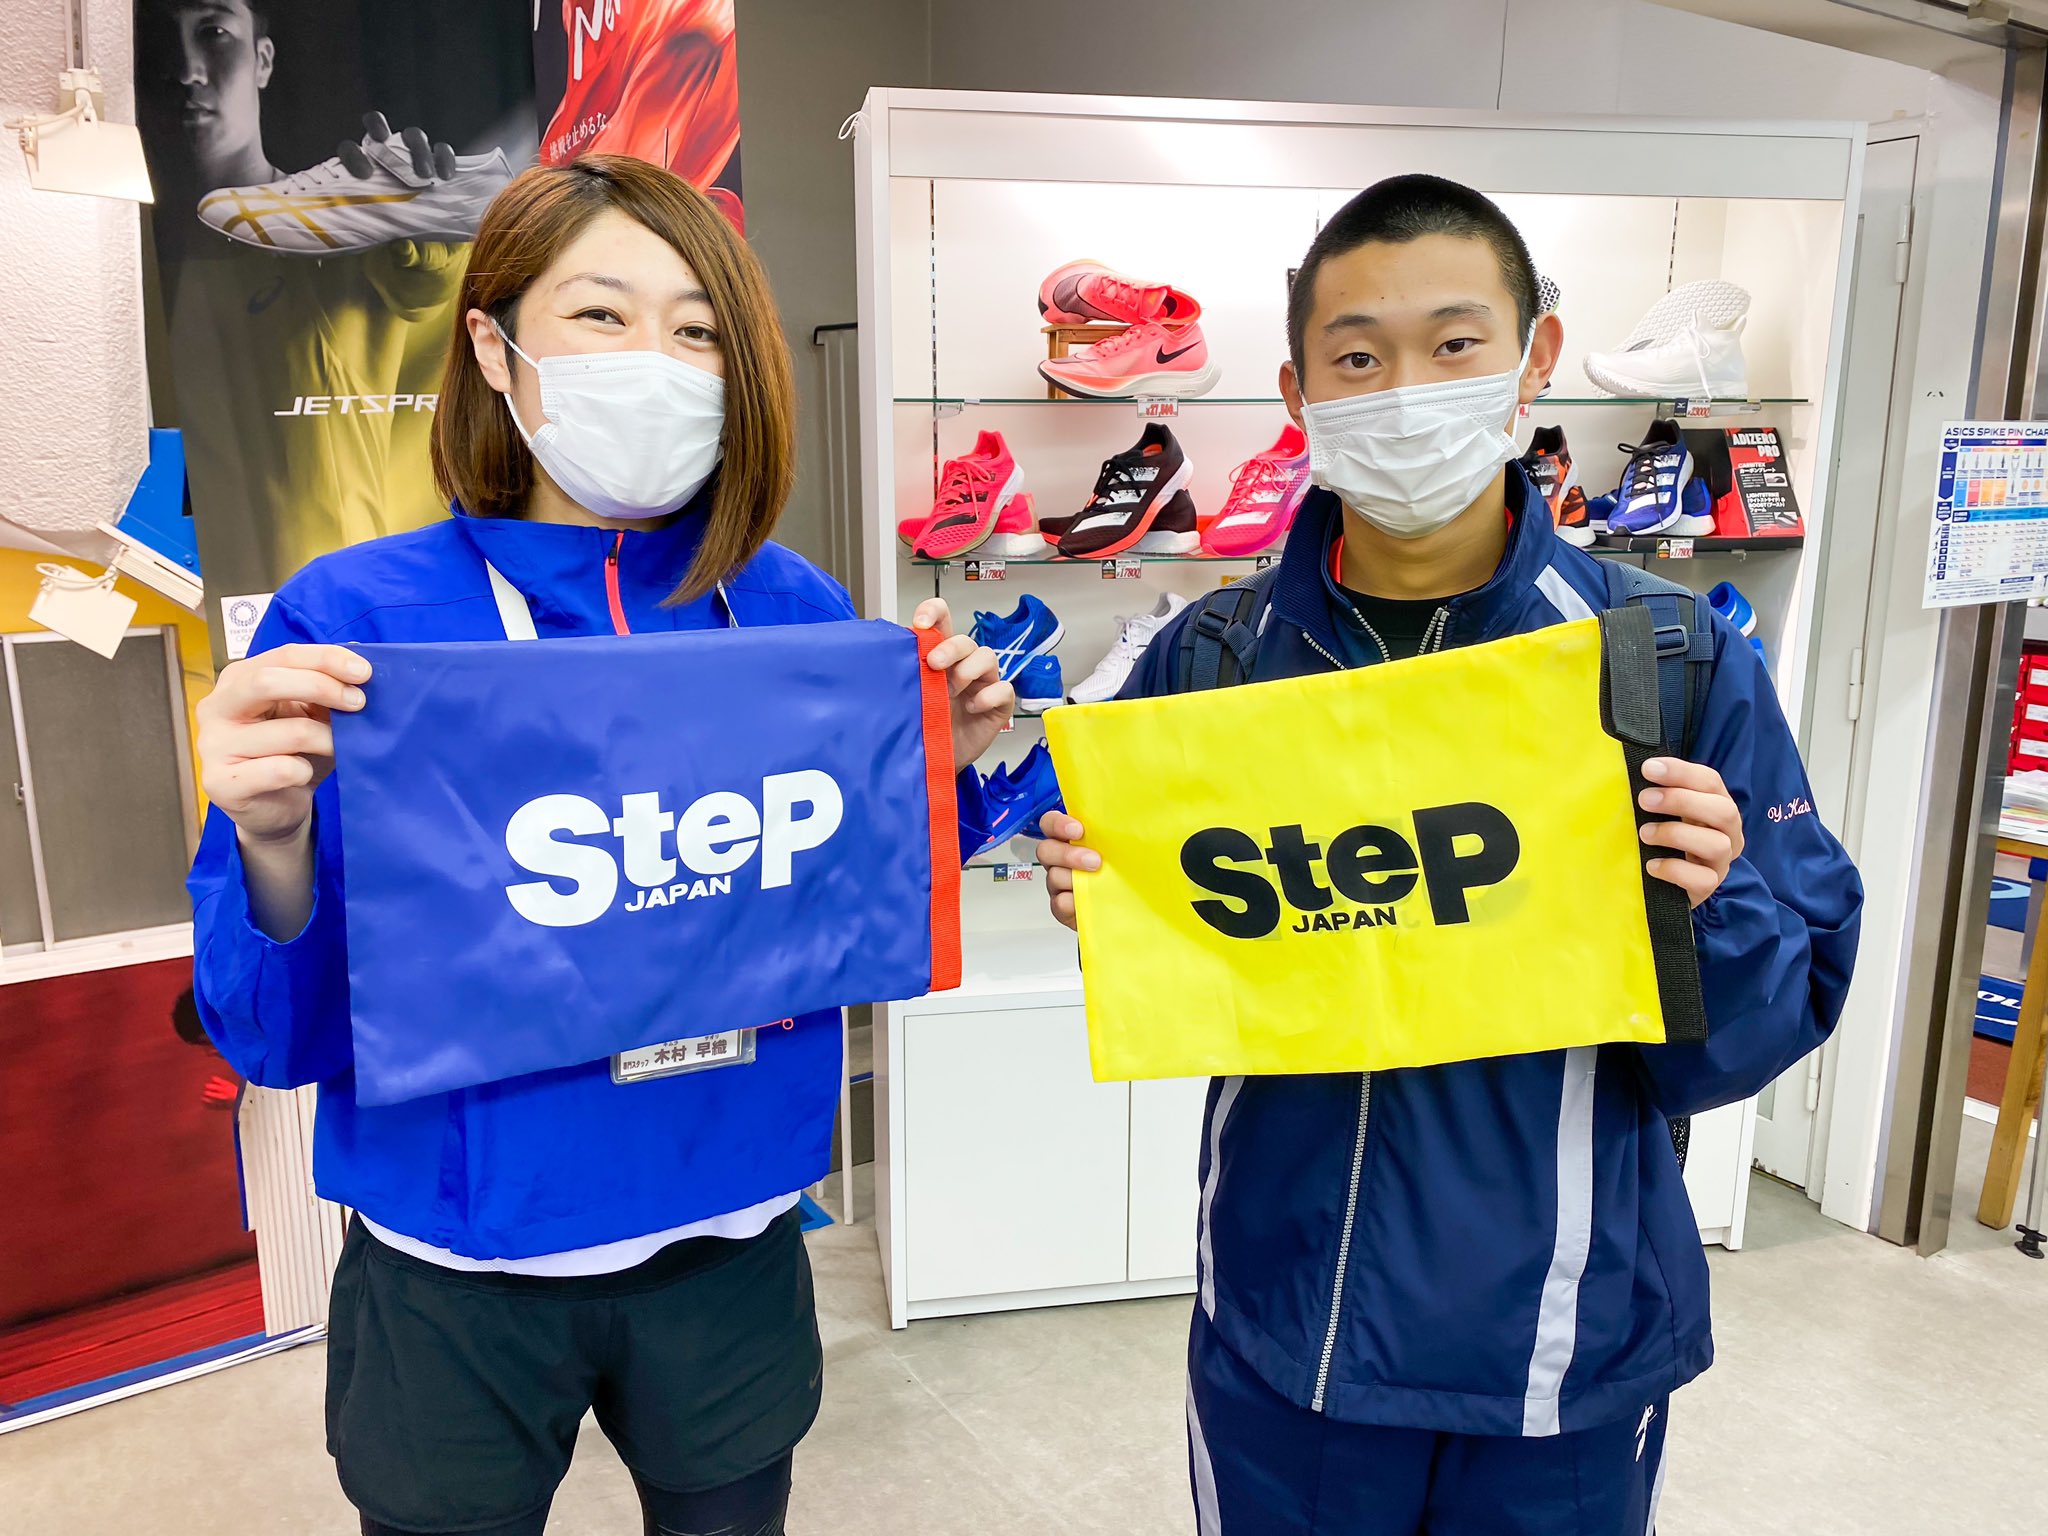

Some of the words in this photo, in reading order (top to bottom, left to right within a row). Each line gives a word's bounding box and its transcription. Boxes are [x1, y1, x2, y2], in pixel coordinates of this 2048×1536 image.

[1732, 433, 1777, 446] ADIZERO
[1945, 428, 1975, 436] ASICS
[1977, 428, 2006, 436] SPIKE
[2007, 428, 2023, 436] PIN
[1757, 445, 1780, 457] PRO
[625, 875, 731, 912] JAPAN
[1293, 906, 1397, 933] JAPAN
[654, 1045, 687, 1064] 木村
[696, 1039, 728, 1058] 早織
